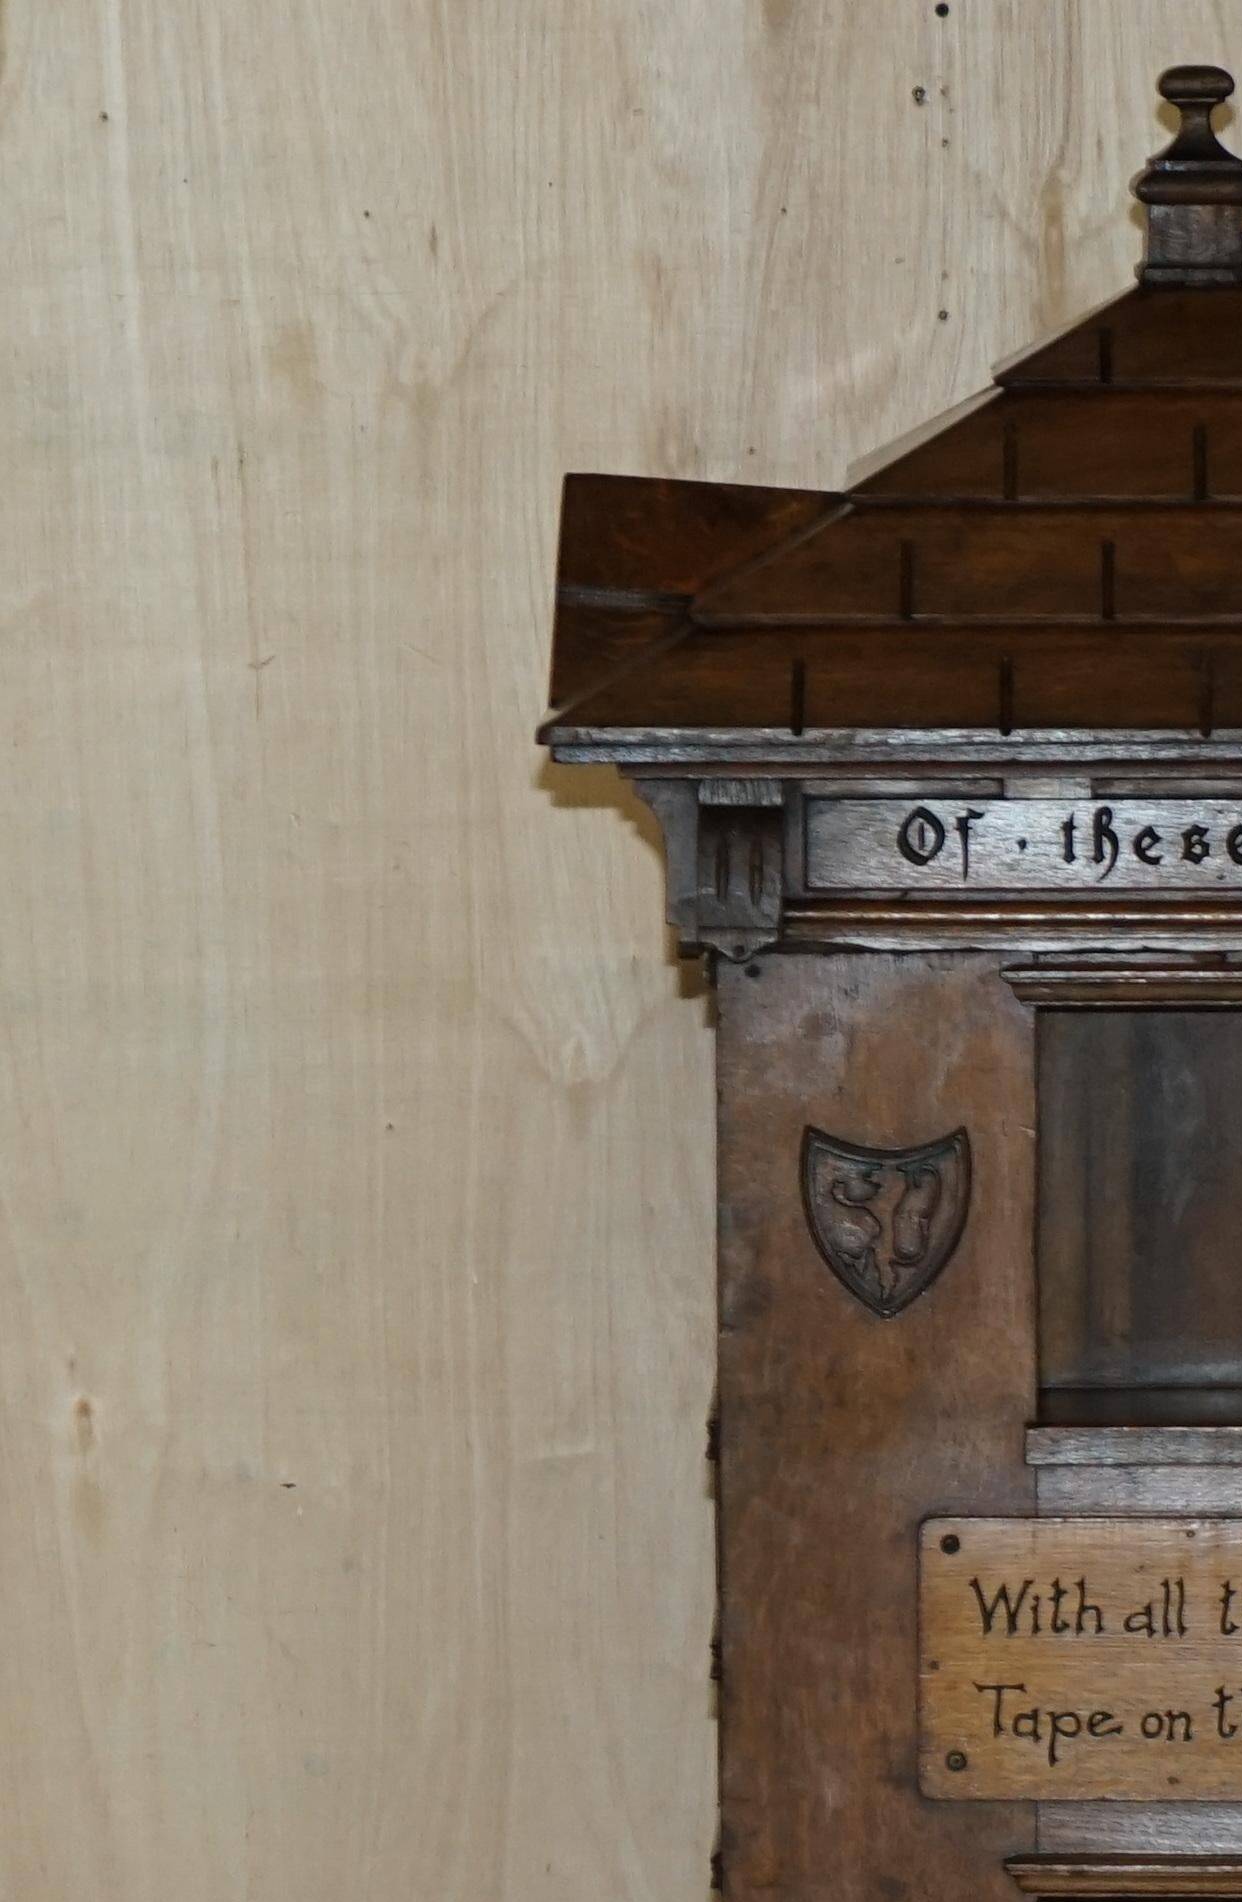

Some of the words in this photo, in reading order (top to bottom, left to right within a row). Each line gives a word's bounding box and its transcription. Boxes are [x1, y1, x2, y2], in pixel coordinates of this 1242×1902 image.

[894, 806, 984, 881] Of
[969, 1575, 1106, 1637] With
[1123, 1576, 1187, 1639] all
[972, 1681, 1122, 1768] Tape
[1140, 1707, 1192, 1742] on
